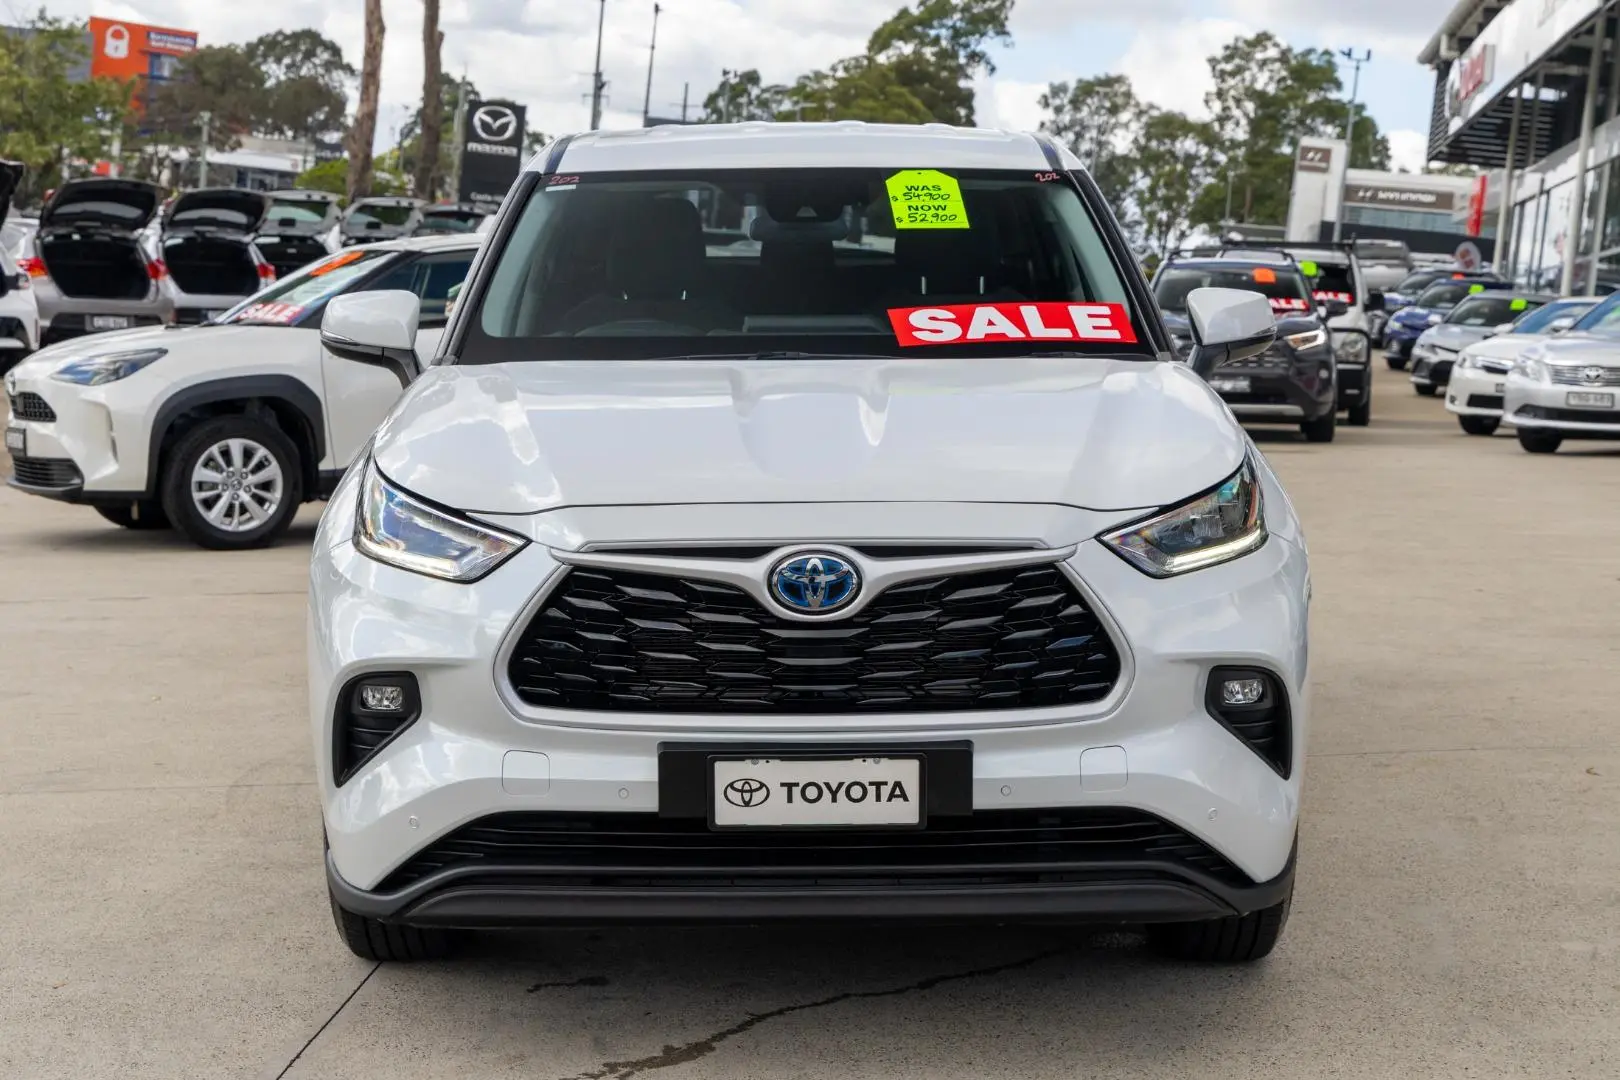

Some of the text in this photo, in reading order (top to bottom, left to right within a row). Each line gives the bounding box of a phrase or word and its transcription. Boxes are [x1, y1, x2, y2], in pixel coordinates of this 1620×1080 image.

[467, 142, 518, 157] mazda
[549, 175, 580, 184] 202
[1034, 172, 1060, 182] 202
[908, 204, 947, 212] NOW
[241, 304, 300, 323] SALE
[908, 305, 1122, 342] SALE
[779, 781, 910, 804] TOYOTA
